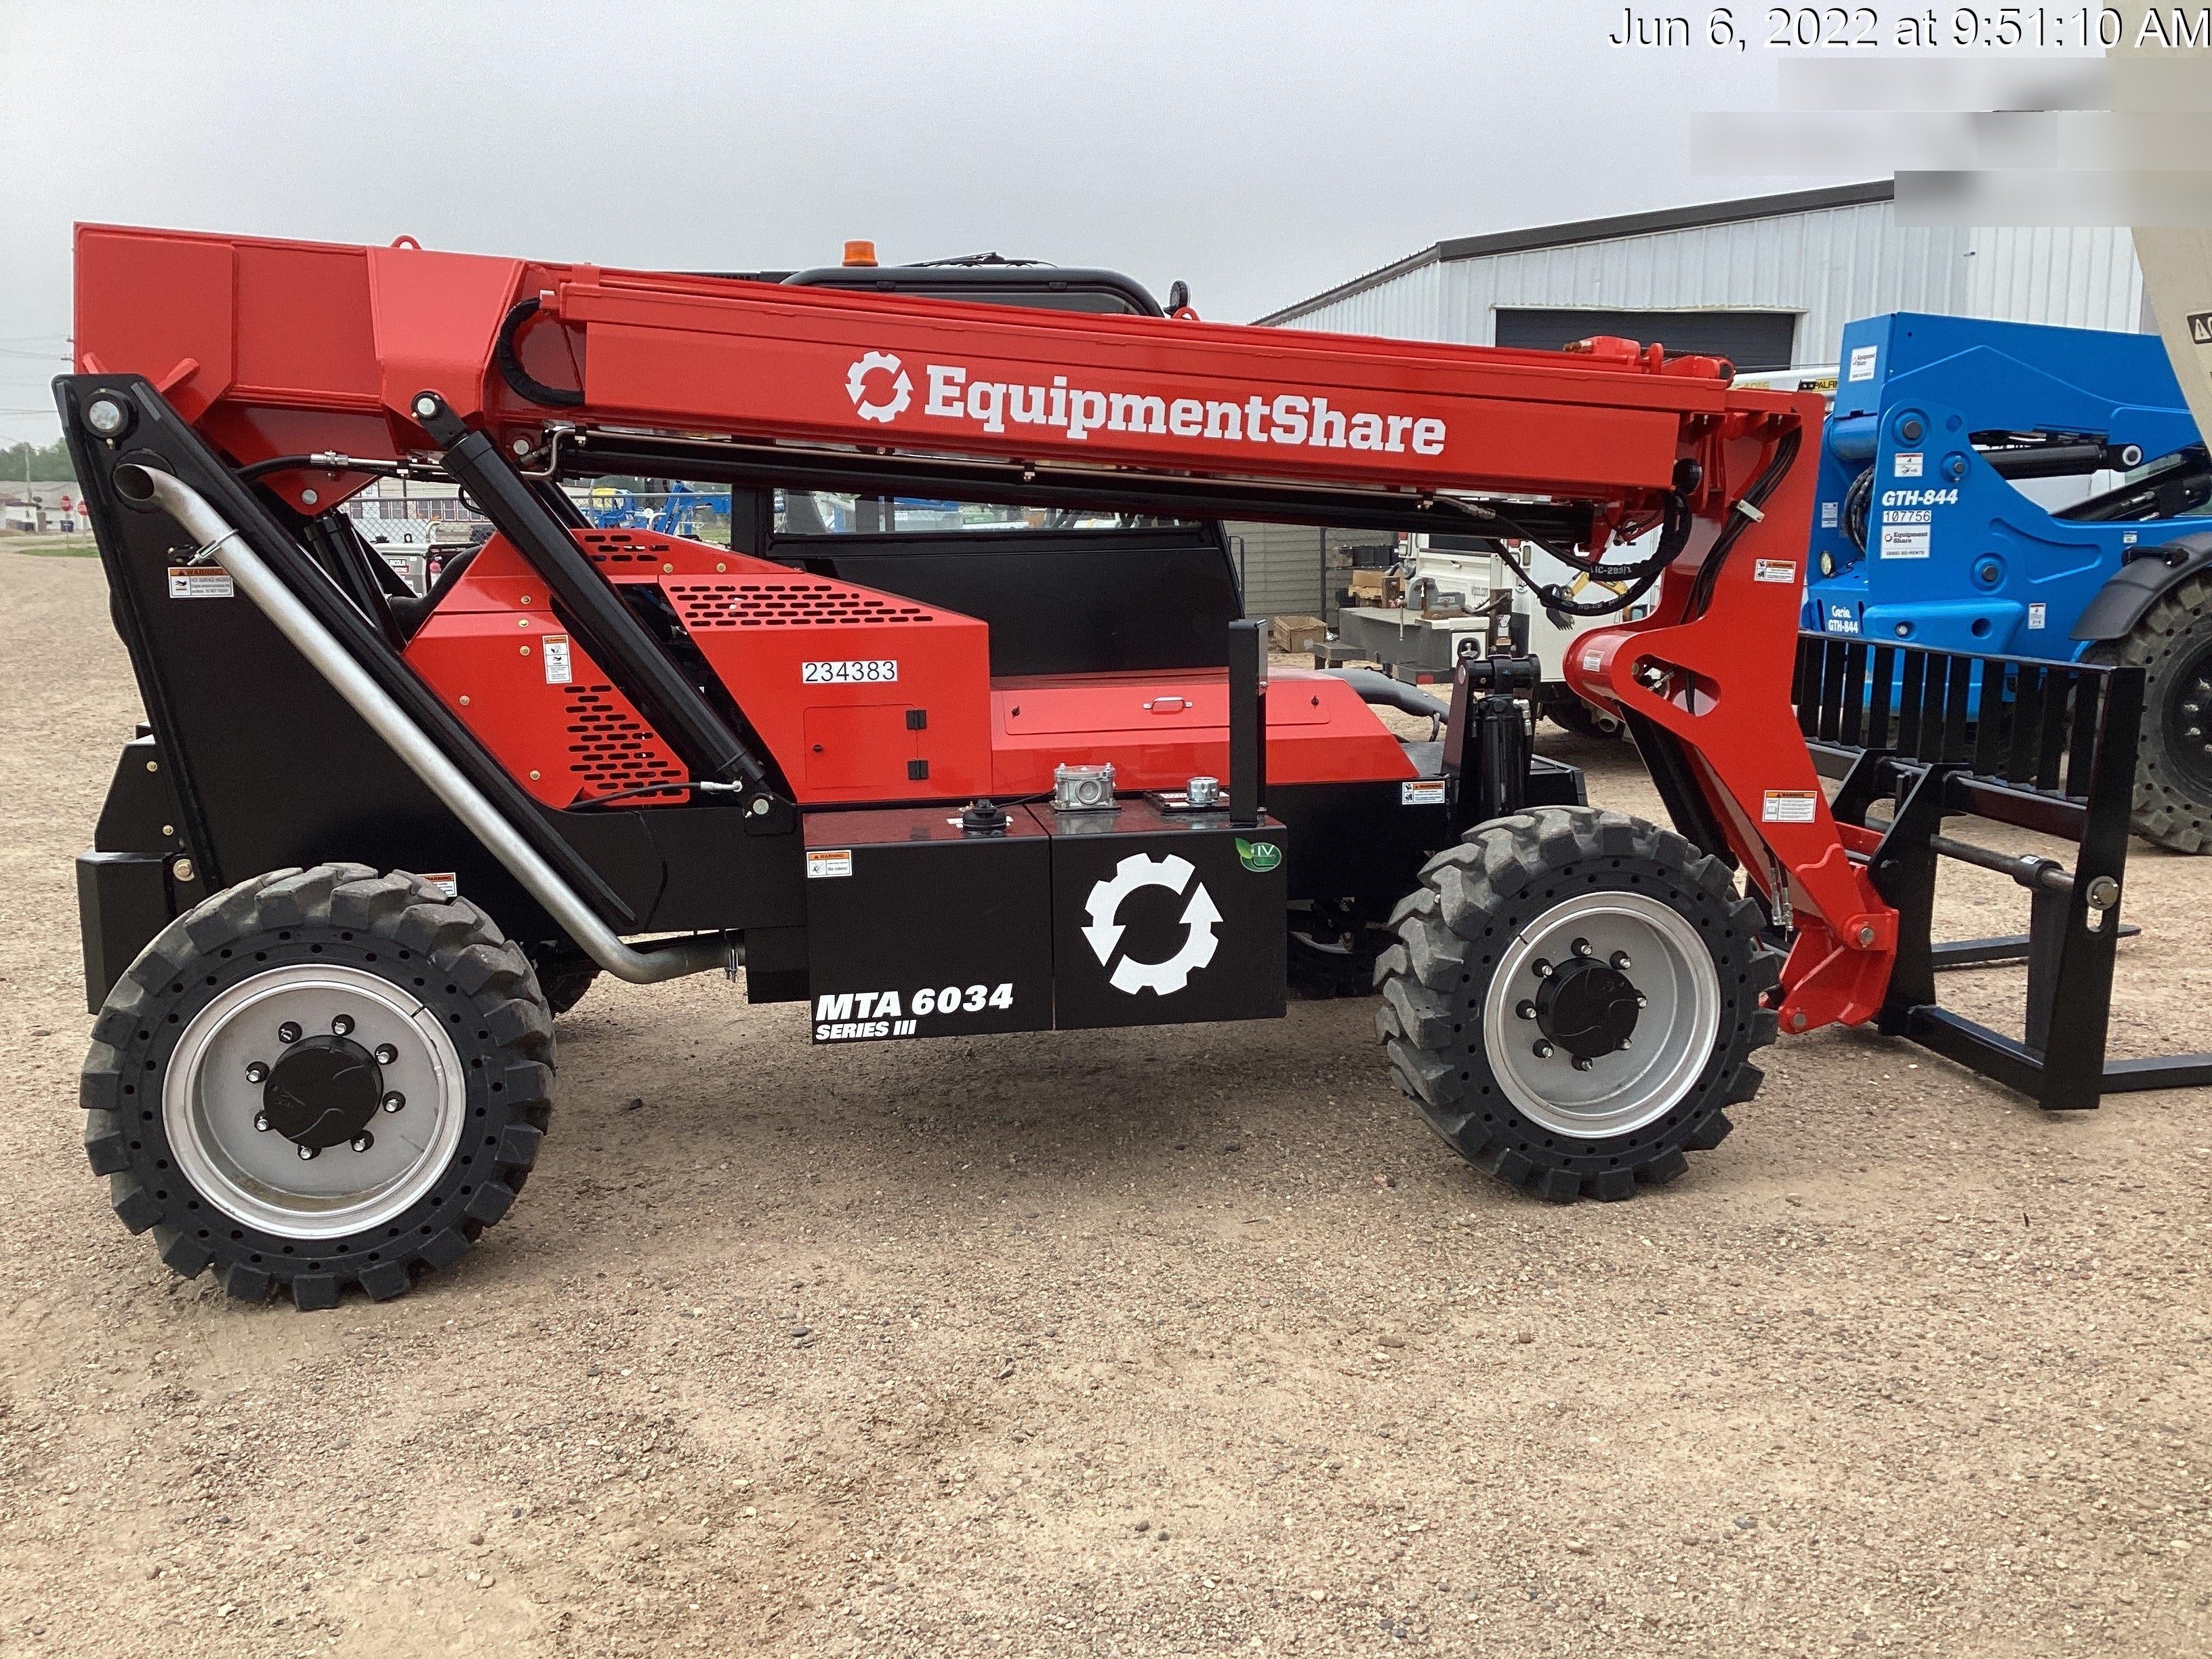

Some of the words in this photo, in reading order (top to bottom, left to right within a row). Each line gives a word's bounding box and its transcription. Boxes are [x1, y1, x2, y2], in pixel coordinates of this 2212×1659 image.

[924, 364, 1447, 455] EquipmentShare
[1882, 489, 1959, 506] GTH-844
[1885, 510, 1931, 522] 107756
[1832, 605, 1851, 618] Genie
[1828, 619, 1858, 633] GTH-844
[804, 661, 896, 682] 234383
[815, 991, 902, 1021] MTA
[912, 982, 1014, 1013] 6034
[815, 1022, 889, 1041] SERIES
[893, 1019, 917, 1037] III
